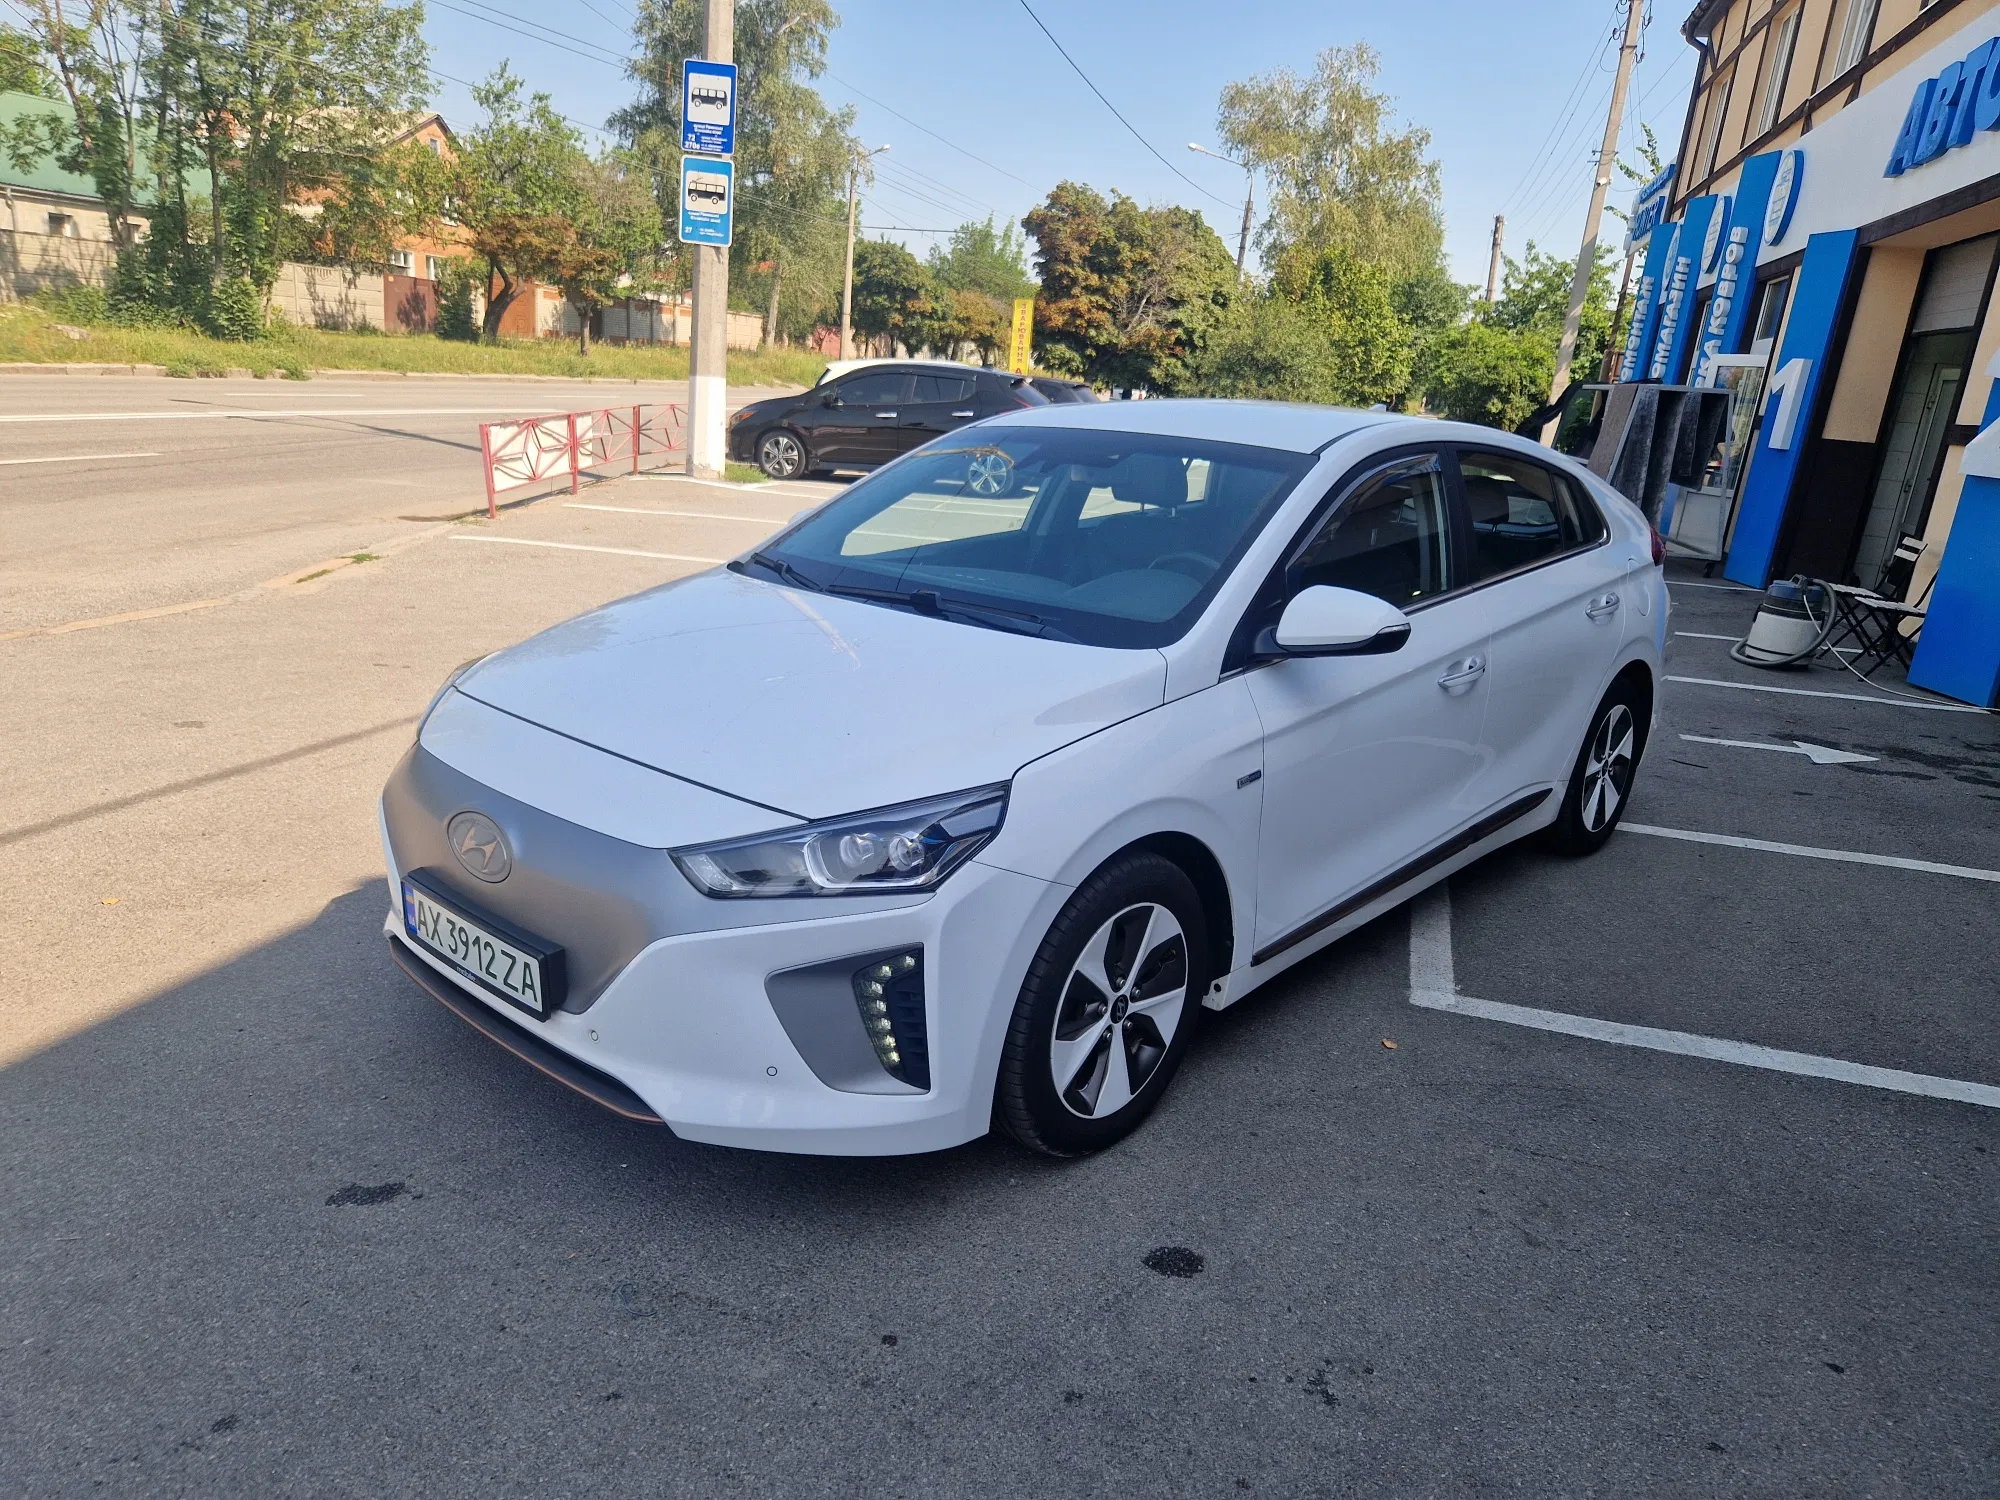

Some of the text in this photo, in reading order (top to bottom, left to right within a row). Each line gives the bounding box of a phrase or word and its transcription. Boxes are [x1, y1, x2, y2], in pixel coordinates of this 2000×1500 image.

[687, 133, 696, 142] 72
[1708, 226, 1748, 336] КОВРОВ
[1017, 303, 1027, 364] ЗВАРЮВАННЯ
[1768, 357, 1813, 450] 1
[417, 900, 538, 1003] AX 3912 ZA
